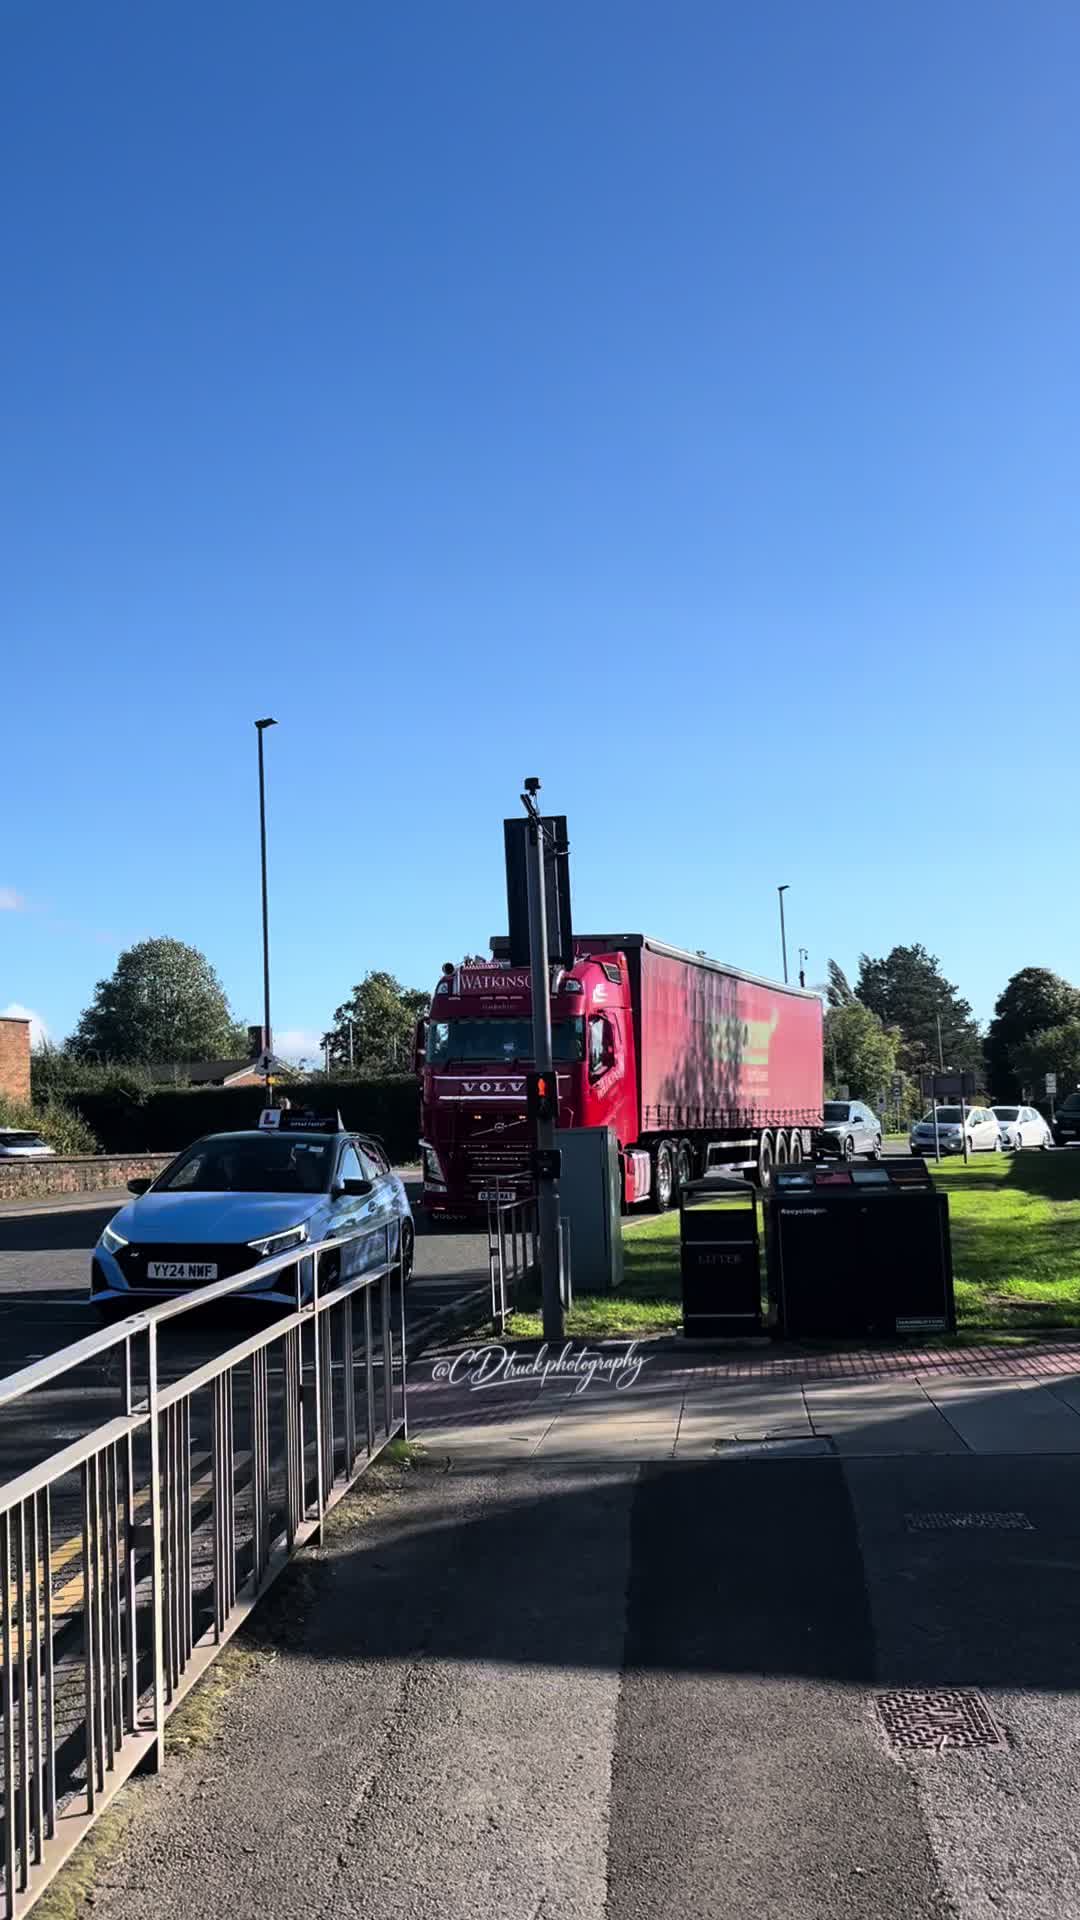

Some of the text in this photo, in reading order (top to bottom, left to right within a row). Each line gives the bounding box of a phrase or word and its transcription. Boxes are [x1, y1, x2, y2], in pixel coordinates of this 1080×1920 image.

[462, 1082, 525, 1092] VOLV
[263, 1111, 277, 1125] L
[153, 1263, 185, 1277] YY24
